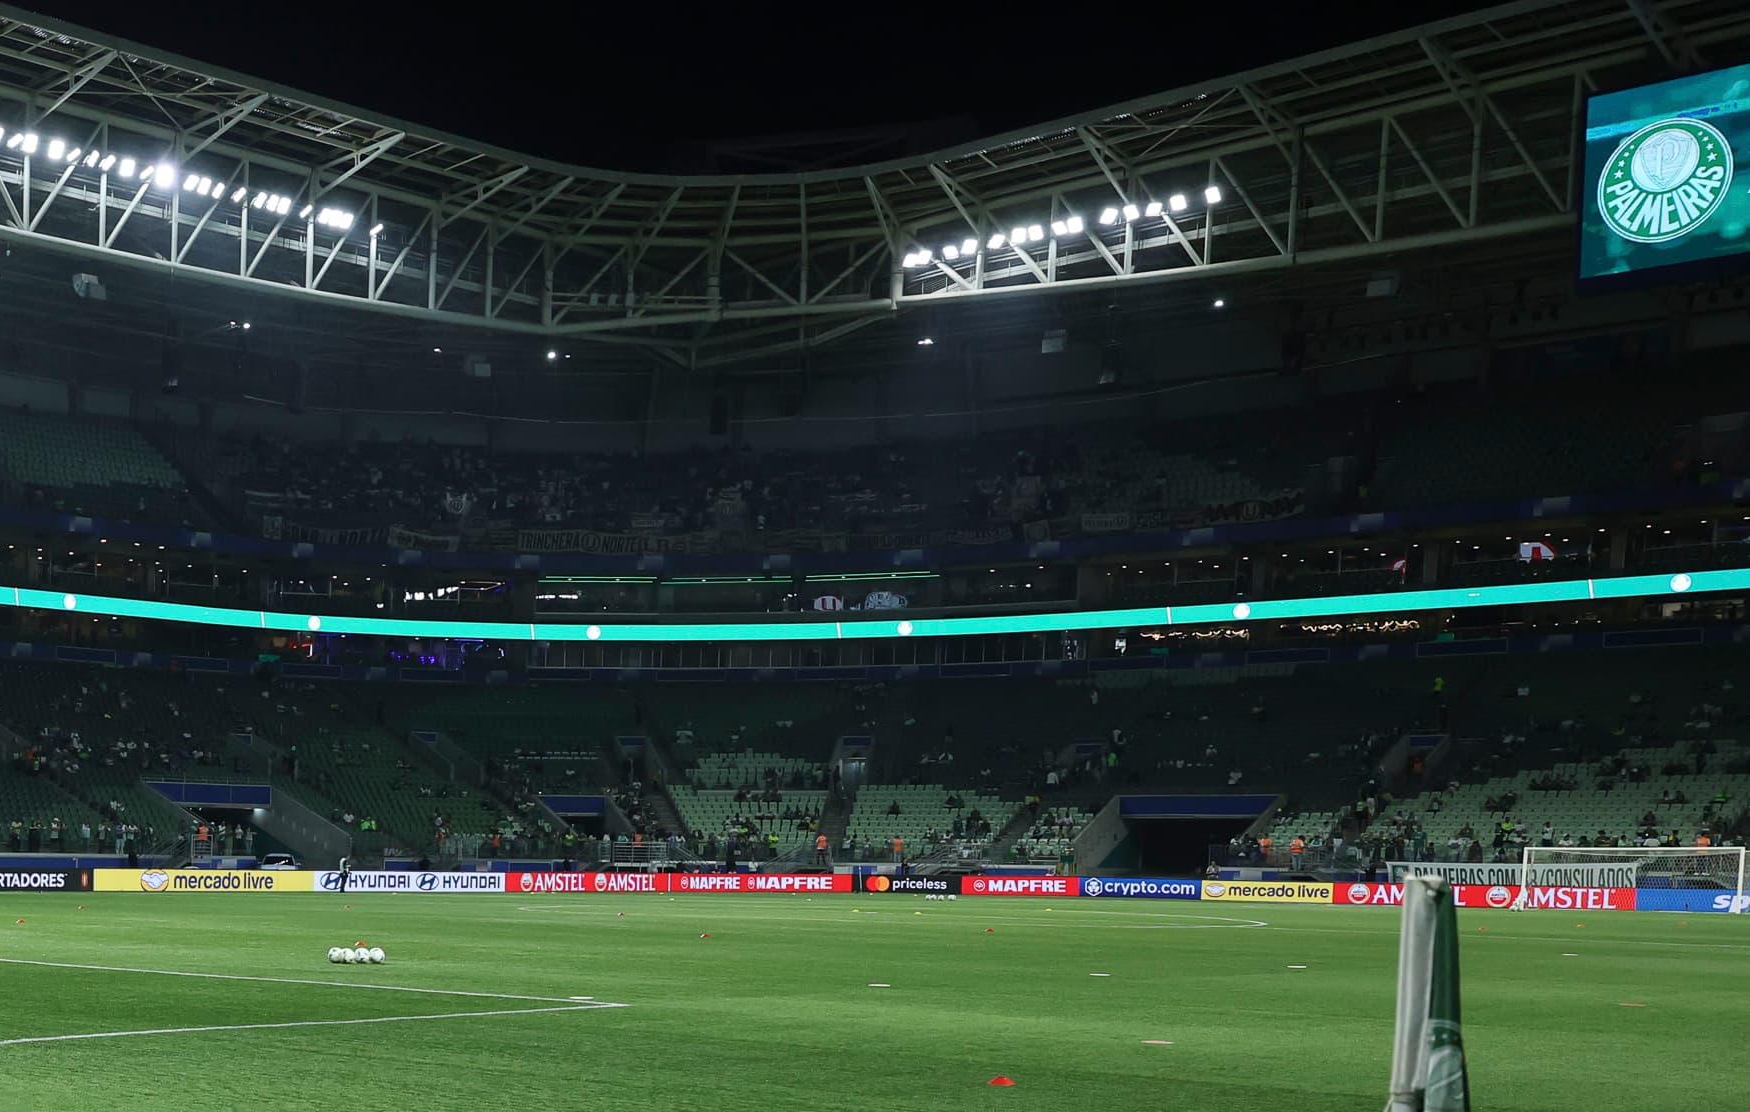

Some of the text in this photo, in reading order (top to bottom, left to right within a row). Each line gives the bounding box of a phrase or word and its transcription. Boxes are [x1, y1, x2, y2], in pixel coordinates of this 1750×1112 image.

[1606, 165, 1725, 235] PALMEIRAS
[173, 871, 274, 889] mercado livre
[349, 874, 411, 889] HYUNDAI
[443, 874, 501, 890] HYUNDAI
[534, 873, 585, 892] AMSTEL
[607, 873, 655, 892] AMSTEL
[689, 876, 741, 890] MAPFRE
[756, 876, 833, 890] MAPFRE
[892, 877, 947, 893] priceless
[988, 879, 1067, 893] MAPFRE
[1104, 879, 1195, 897] crypto.com
[1228, 884, 1330, 898] mercado livre
